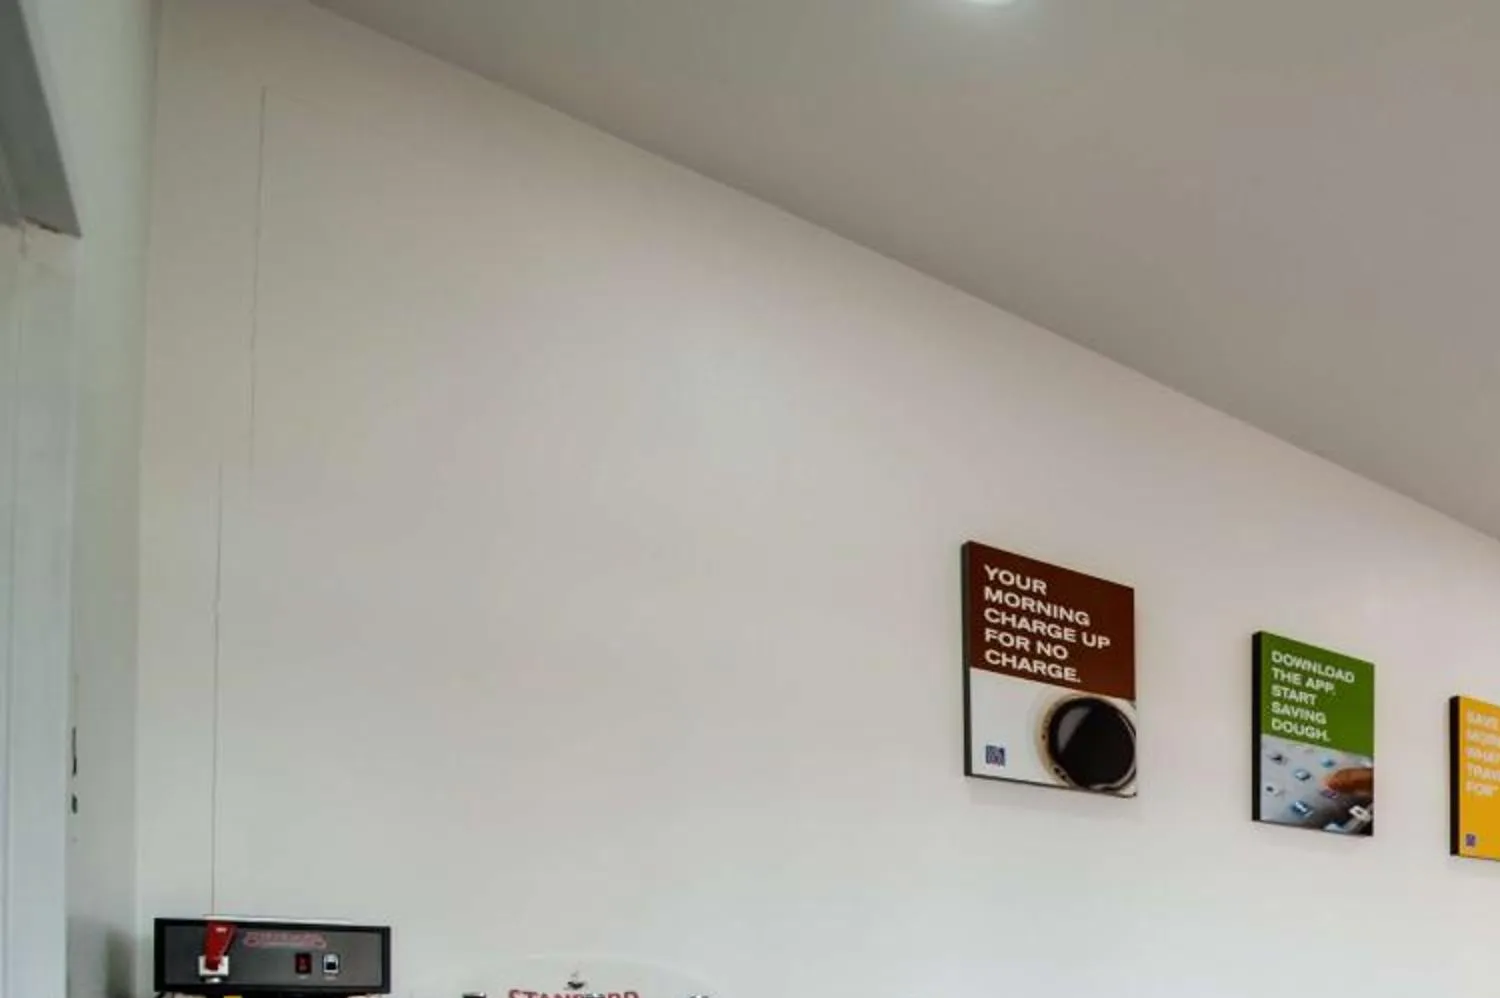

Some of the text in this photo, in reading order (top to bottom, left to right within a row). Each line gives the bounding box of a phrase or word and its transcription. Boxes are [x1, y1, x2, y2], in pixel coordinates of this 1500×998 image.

[984, 564, 1047, 595] YOUR
[984, 586, 1091, 626] MORNING
[984, 608, 1111, 649] CHARGE UP
[984, 628, 1068, 660] FOR NO
[984, 650, 1081, 683] CHARGE.
[1271, 650, 1355, 683] DOWNLOAD
[1271, 667, 1302, 684] THE
[1271, 685, 1317, 705] START
[1271, 701, 1327, 724] SAVING
[1466, 710, 1498, 729] SAVE
[1271, 718, 1331, 742] DOUGH.
